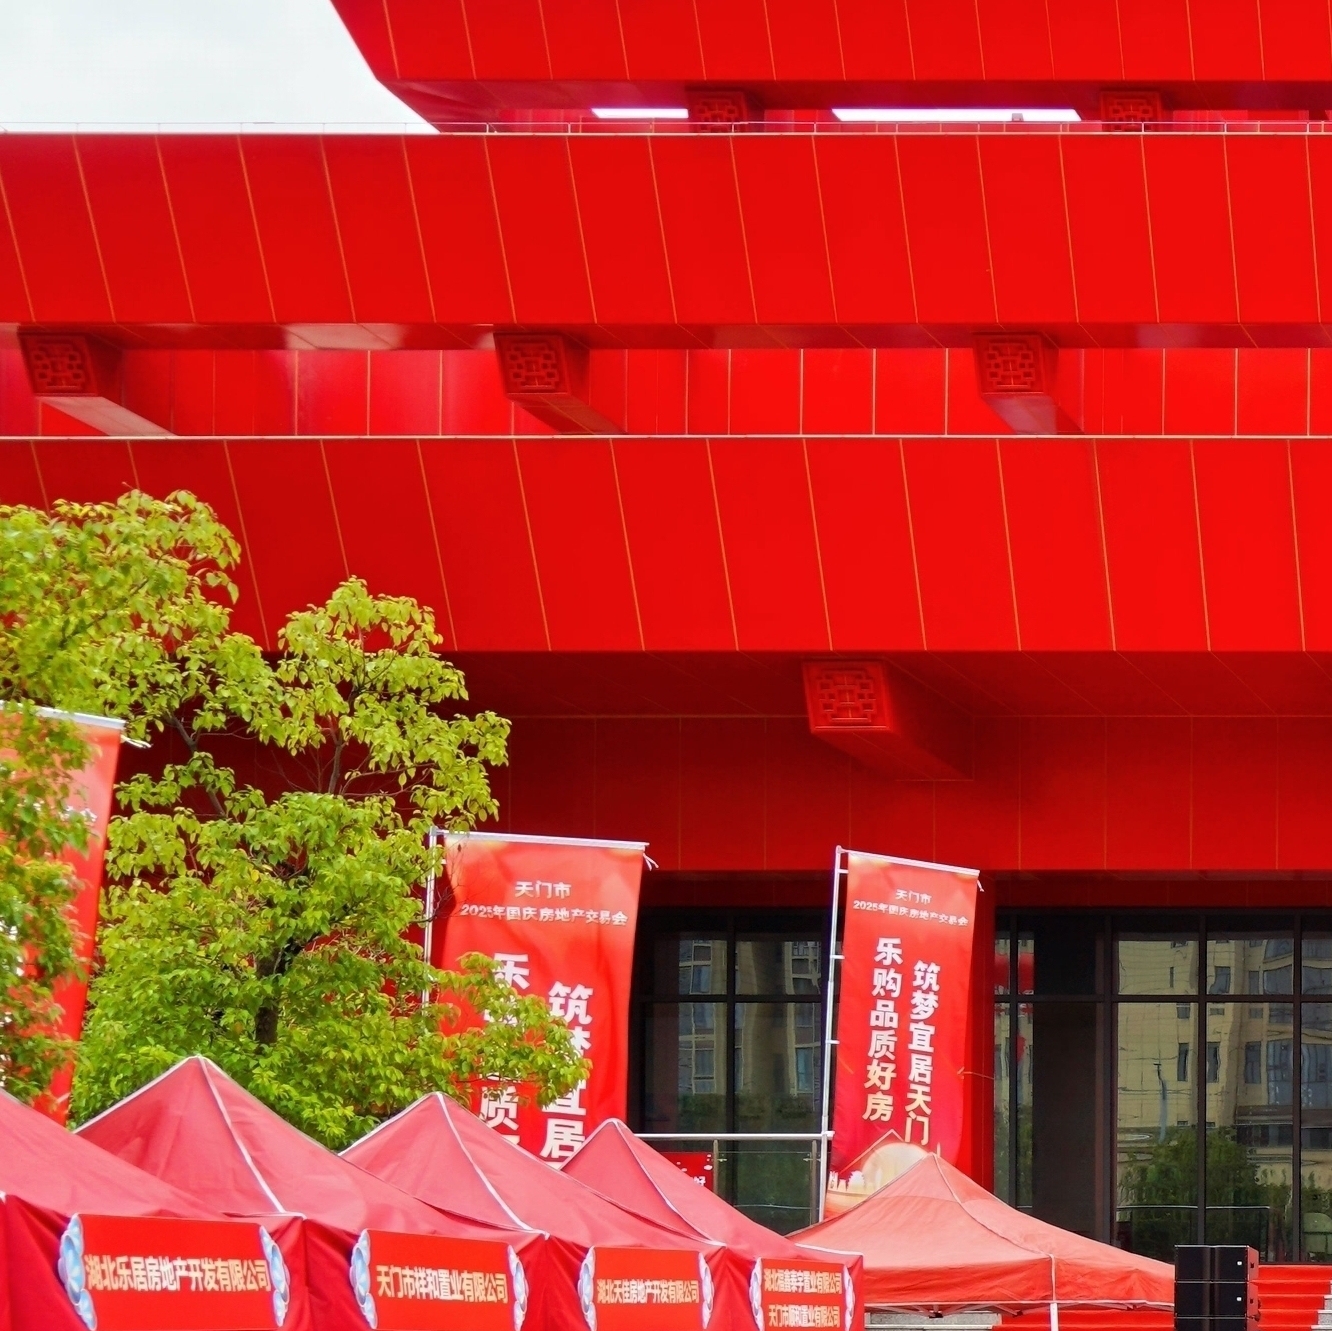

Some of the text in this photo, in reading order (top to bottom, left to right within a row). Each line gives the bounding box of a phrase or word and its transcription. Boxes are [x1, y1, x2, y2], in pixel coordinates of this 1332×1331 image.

[515, 880, 573, 900] 天门市
[895, 889, 932, 905] 天门市
[459, 903, 629, 927] 2025年国庆房地产交易会
[853, 900, 969, 927] 2025年国庆房地产交易会
[862, 937, 904, 1123] 乐购品质好房
[904, 959, 941, 1147] 筑梦宜居天门
[85, 1254, 271, 1292] 湖北乐居房地产开发有限公司
[376, 1264, 509, 1304] 天门市祥和置业有限公司
[597, 1278, 700, 1304] 湖北天佳房地产开发有限公司
